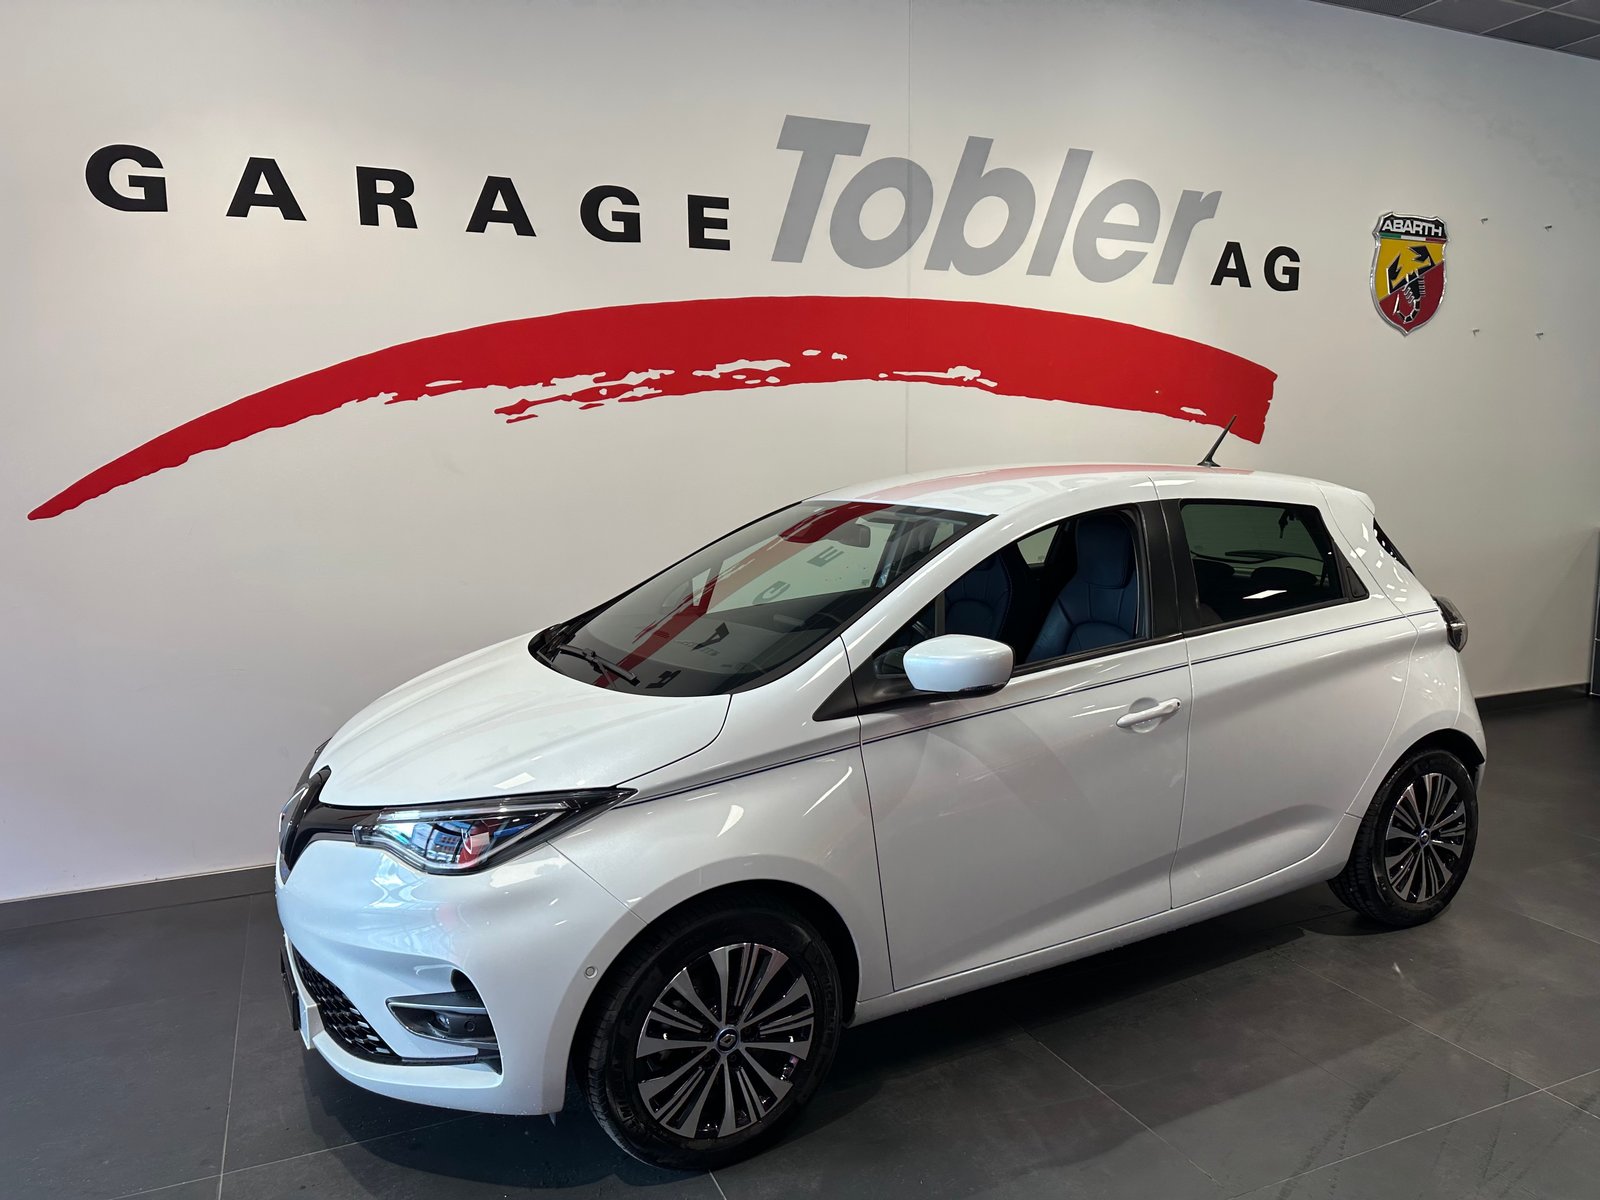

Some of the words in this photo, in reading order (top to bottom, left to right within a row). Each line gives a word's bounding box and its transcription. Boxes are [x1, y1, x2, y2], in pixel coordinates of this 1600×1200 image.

[85, 144, 731, 251] GARAGE
[771, 114, 1223, 285] Tobler
[1210, 241, 1301, 292] AG
[1382, 219, 1442, 236] ABARTH
